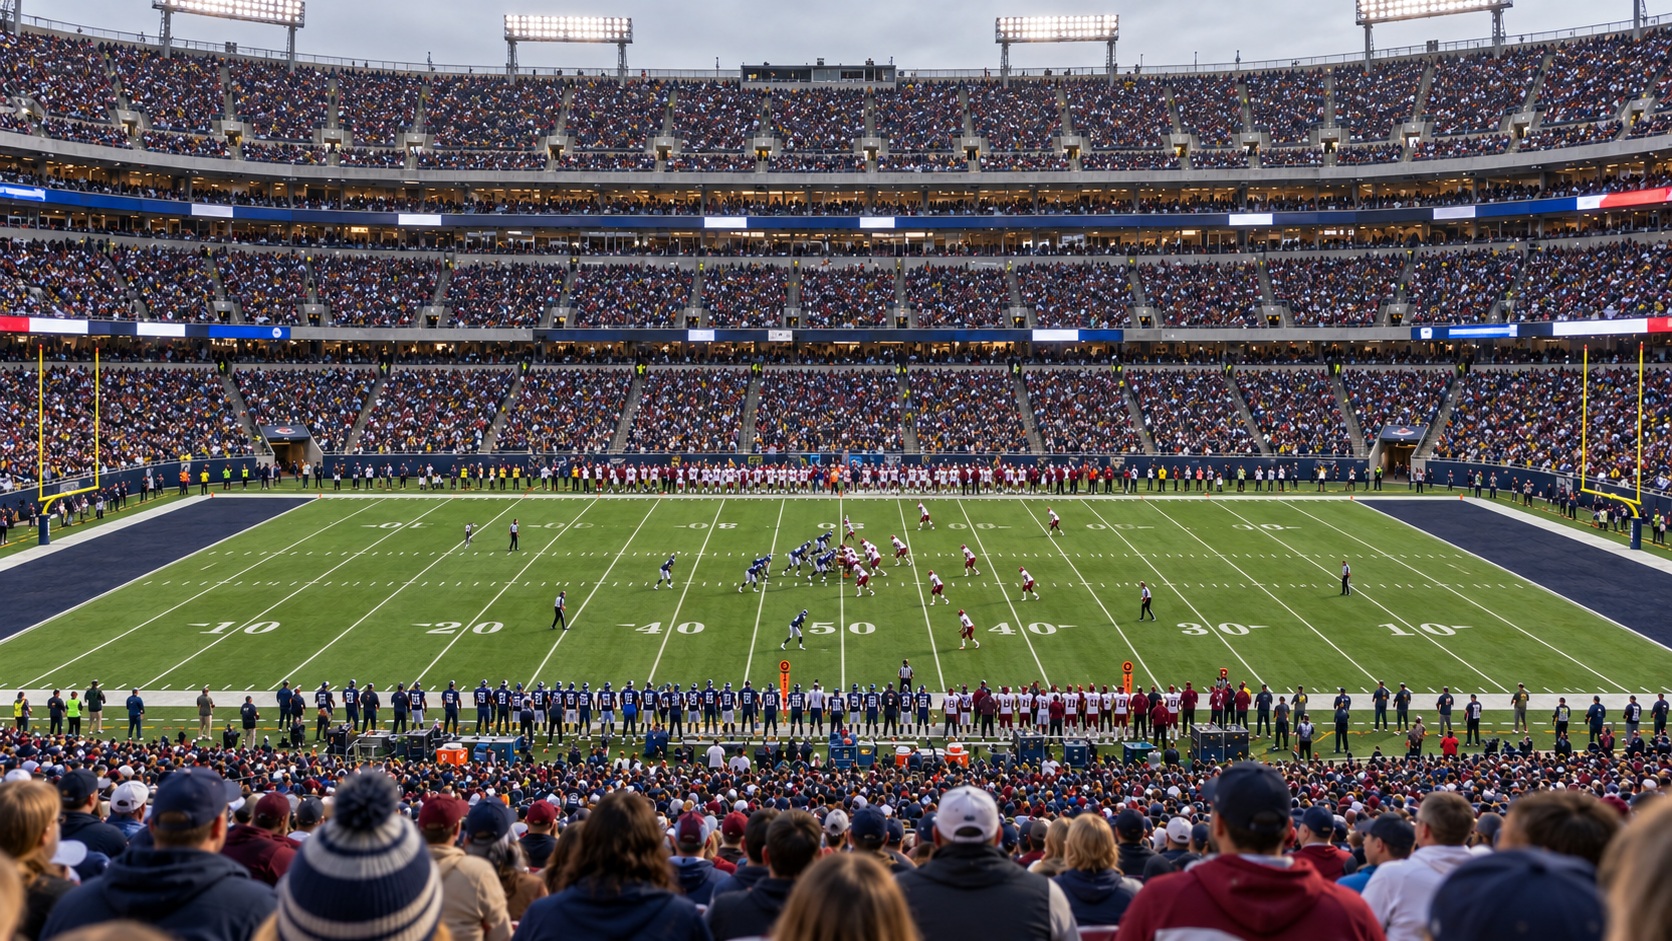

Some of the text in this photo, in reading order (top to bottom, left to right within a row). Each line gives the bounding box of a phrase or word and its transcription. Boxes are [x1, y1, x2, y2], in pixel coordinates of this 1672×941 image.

[199, 621, 281, 634] 10
[425, 621, 504, 634] 20
[635, 621, 706, 634] 40
[809, 621, 876, 635] 50
[988, 622, 1057, 635] 40
[1176, 622, 1250, 635] 30
[1378, 622, 1457, 636] 10
